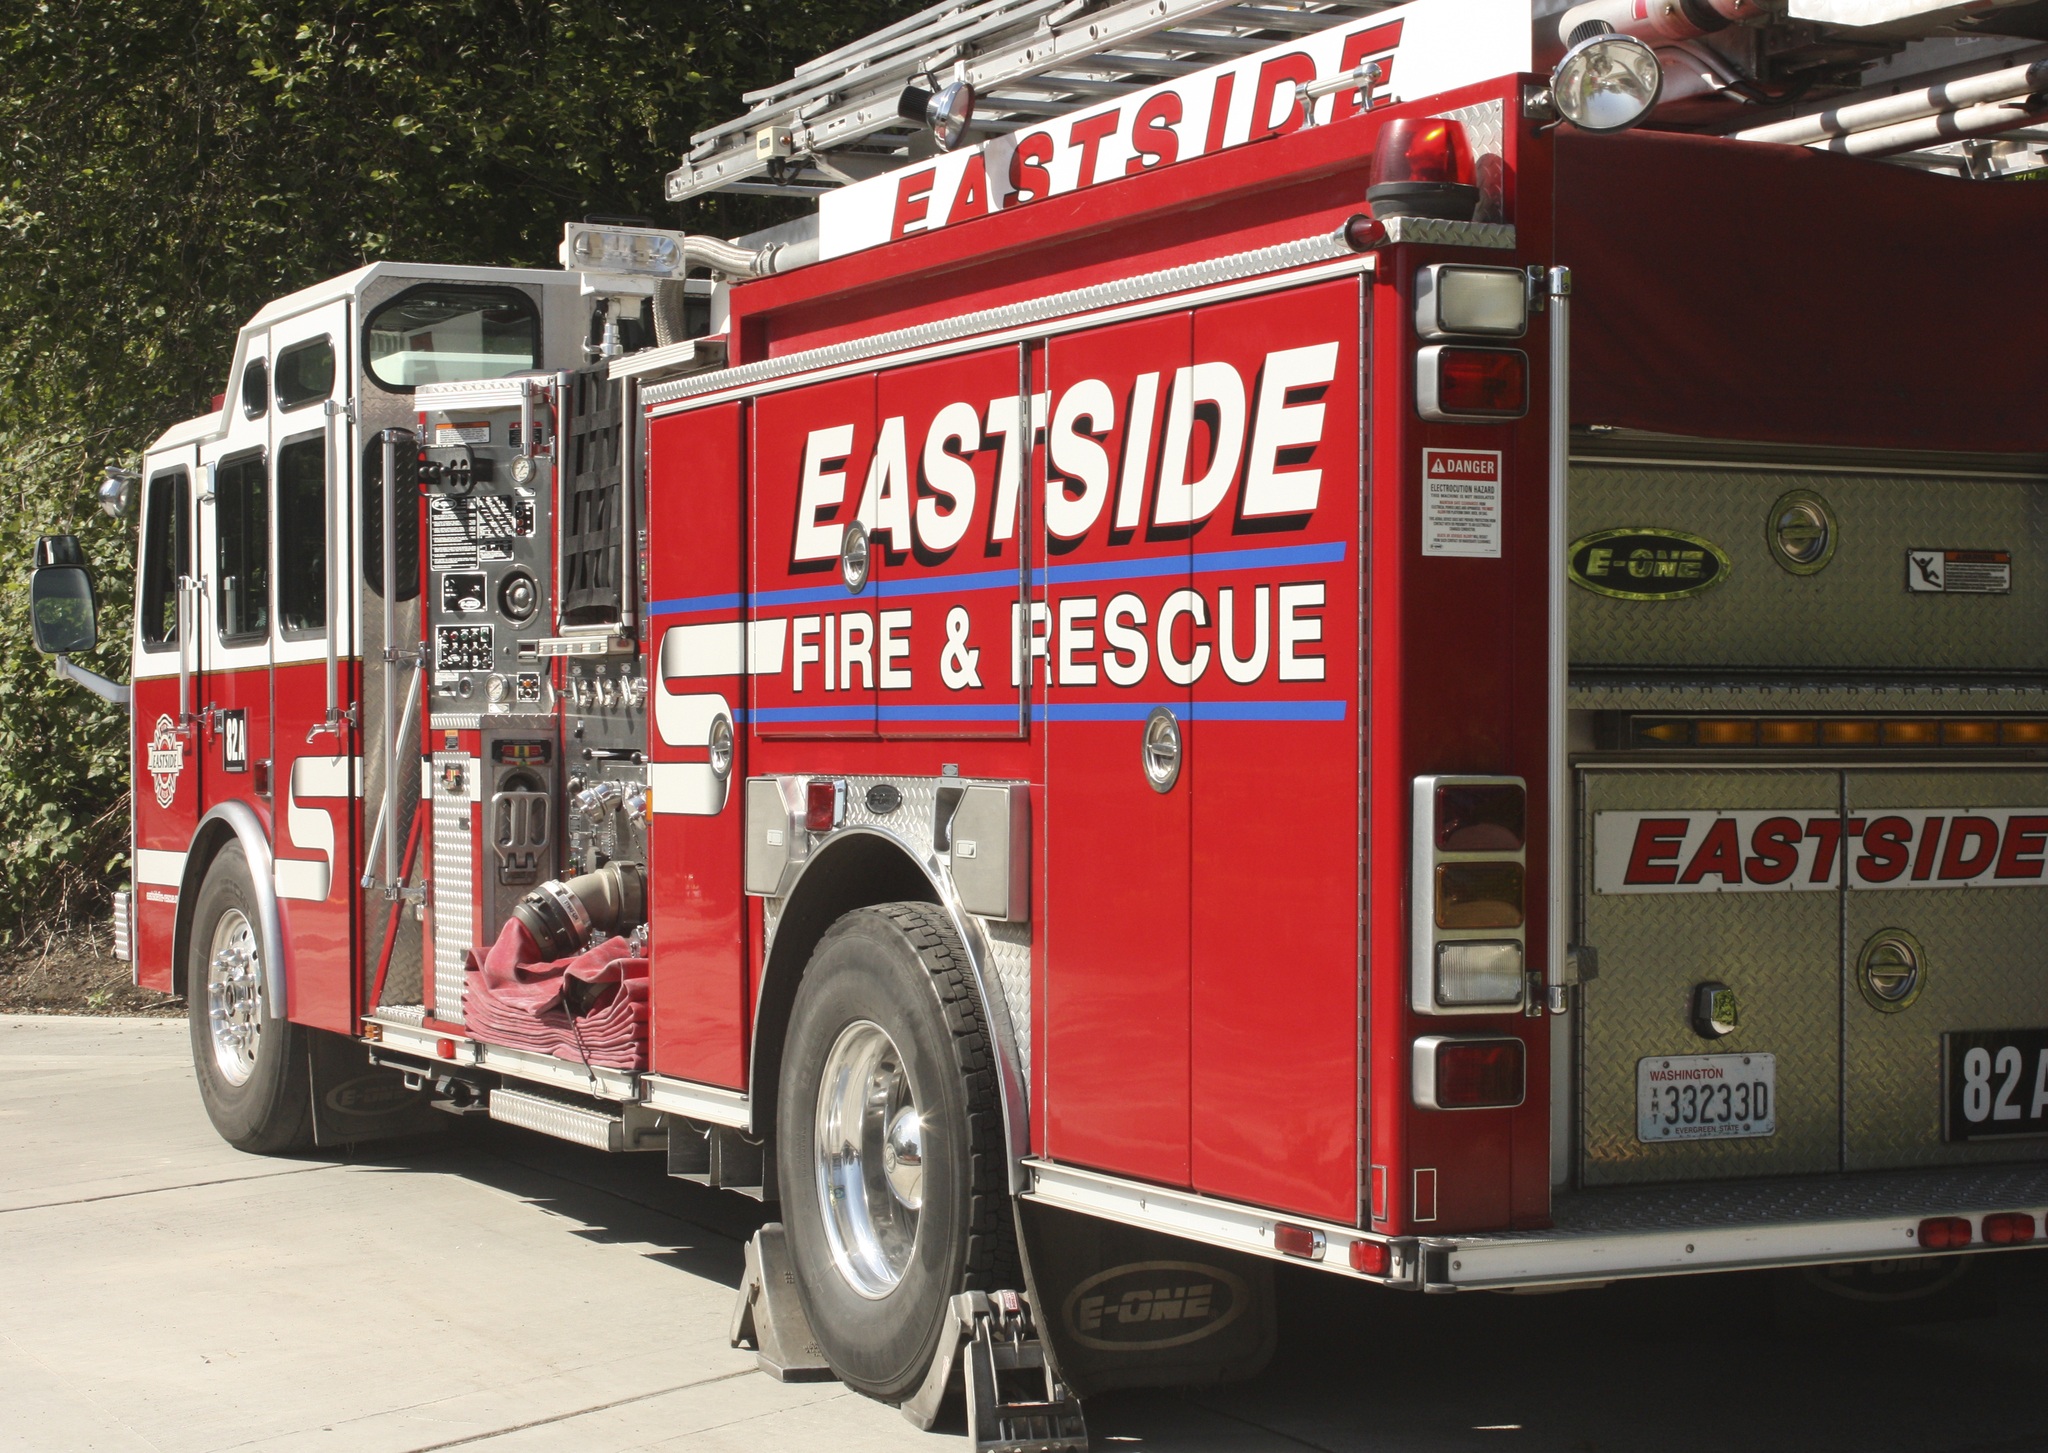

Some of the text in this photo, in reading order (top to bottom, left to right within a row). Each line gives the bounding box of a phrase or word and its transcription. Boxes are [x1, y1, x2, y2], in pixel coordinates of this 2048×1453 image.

[890, 18, 1405, 241] EASTSIDE
[790, 341, 1339, 574] EASTSIDE
[1447, 459, 1495, 474] DANGER
[1430, 483, 1495, 494] ELECTROCUTION HAZARD
[1585, 547, 1705, 579] E-ONE
[792, 582, 1326, 691] FIRE & RESCUE
[152, 753, 178, 769] EASTSIDE
[226, 718, 245, 762] 82A
[1623, 815, 2048, 885] EASTSIDE
[1649, 1068, 1724, 1082] WASHINGTON
[1665, 1082, 1768, 1125] 33233D
[1675, 1124, 1739, 1135] EVERGREEN STATE
[1080, 1283, 1213, 1331] E-ONE
